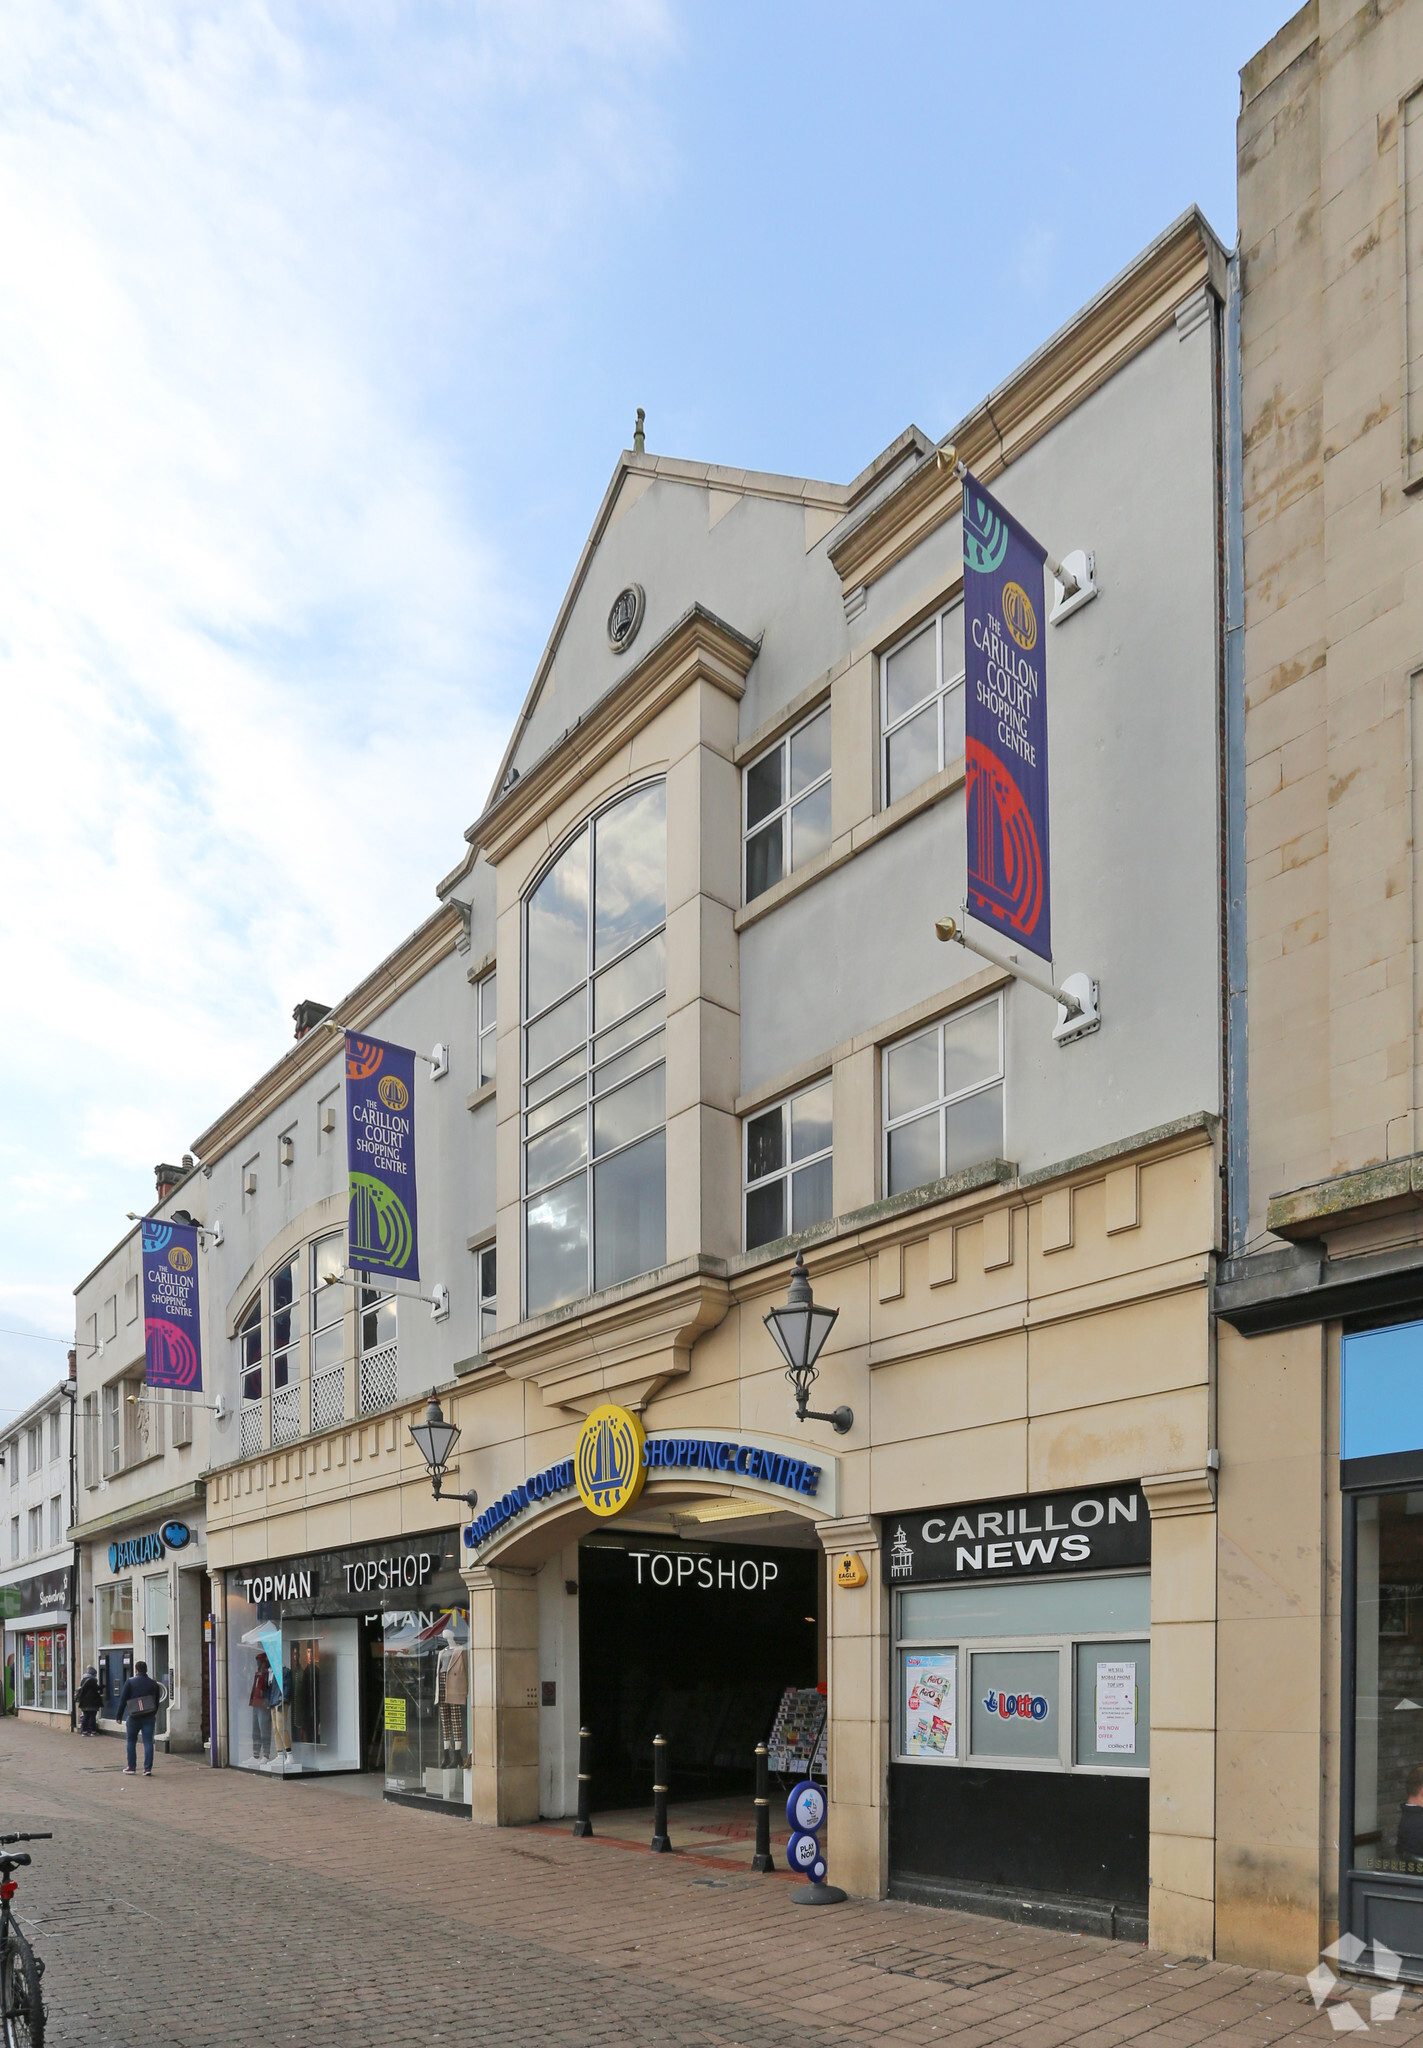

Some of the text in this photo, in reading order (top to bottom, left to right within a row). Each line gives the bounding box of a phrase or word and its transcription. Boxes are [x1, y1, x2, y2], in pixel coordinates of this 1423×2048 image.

[987, 613, 1002, 637] THE
[972, 618, 1038, 698] CARILLON
[987, 660, 1032, 718] COURT
[976, 680, 1028, 738] SHOPPING
[997, 721, 1036, 768] CENTRE
[366, 1099, 378, 1110] THE
[352, 1105, 410, 1135] CARILLON
[356, 1139, 400, 1161] SHOPPING
[365, 1125, 405, 1149] COURT
[374, 1156, 408, 1175] CENTRE
[148, 1270, 194, 1288] CARILLON
[158, 1265, 169, 1273] THE
[151, 1293, 187, 1308] SHOPPING
[158, 1283, 190, 1299] COURT
[165, 1305, 193, 1317] CENTRE
[463, 1439, 821, 1549] CARILLON COURT SHOPPING CENTRE
[922, 1494, 1138, 1544] CARILLON
[117, 1531, 161, 1569] BARCLAYS
[956, 1534, 1091, 1571] NEWS
[343, 1552, 432, 1594] TOPSHOP
[628, 1552, 778, 1590] TOPSHOP
[244, 1570, 312, 1604] TOPMAN
[800, 1842, 814, 1852] PLAY
[800, 1851, 815, 1860] NOW
